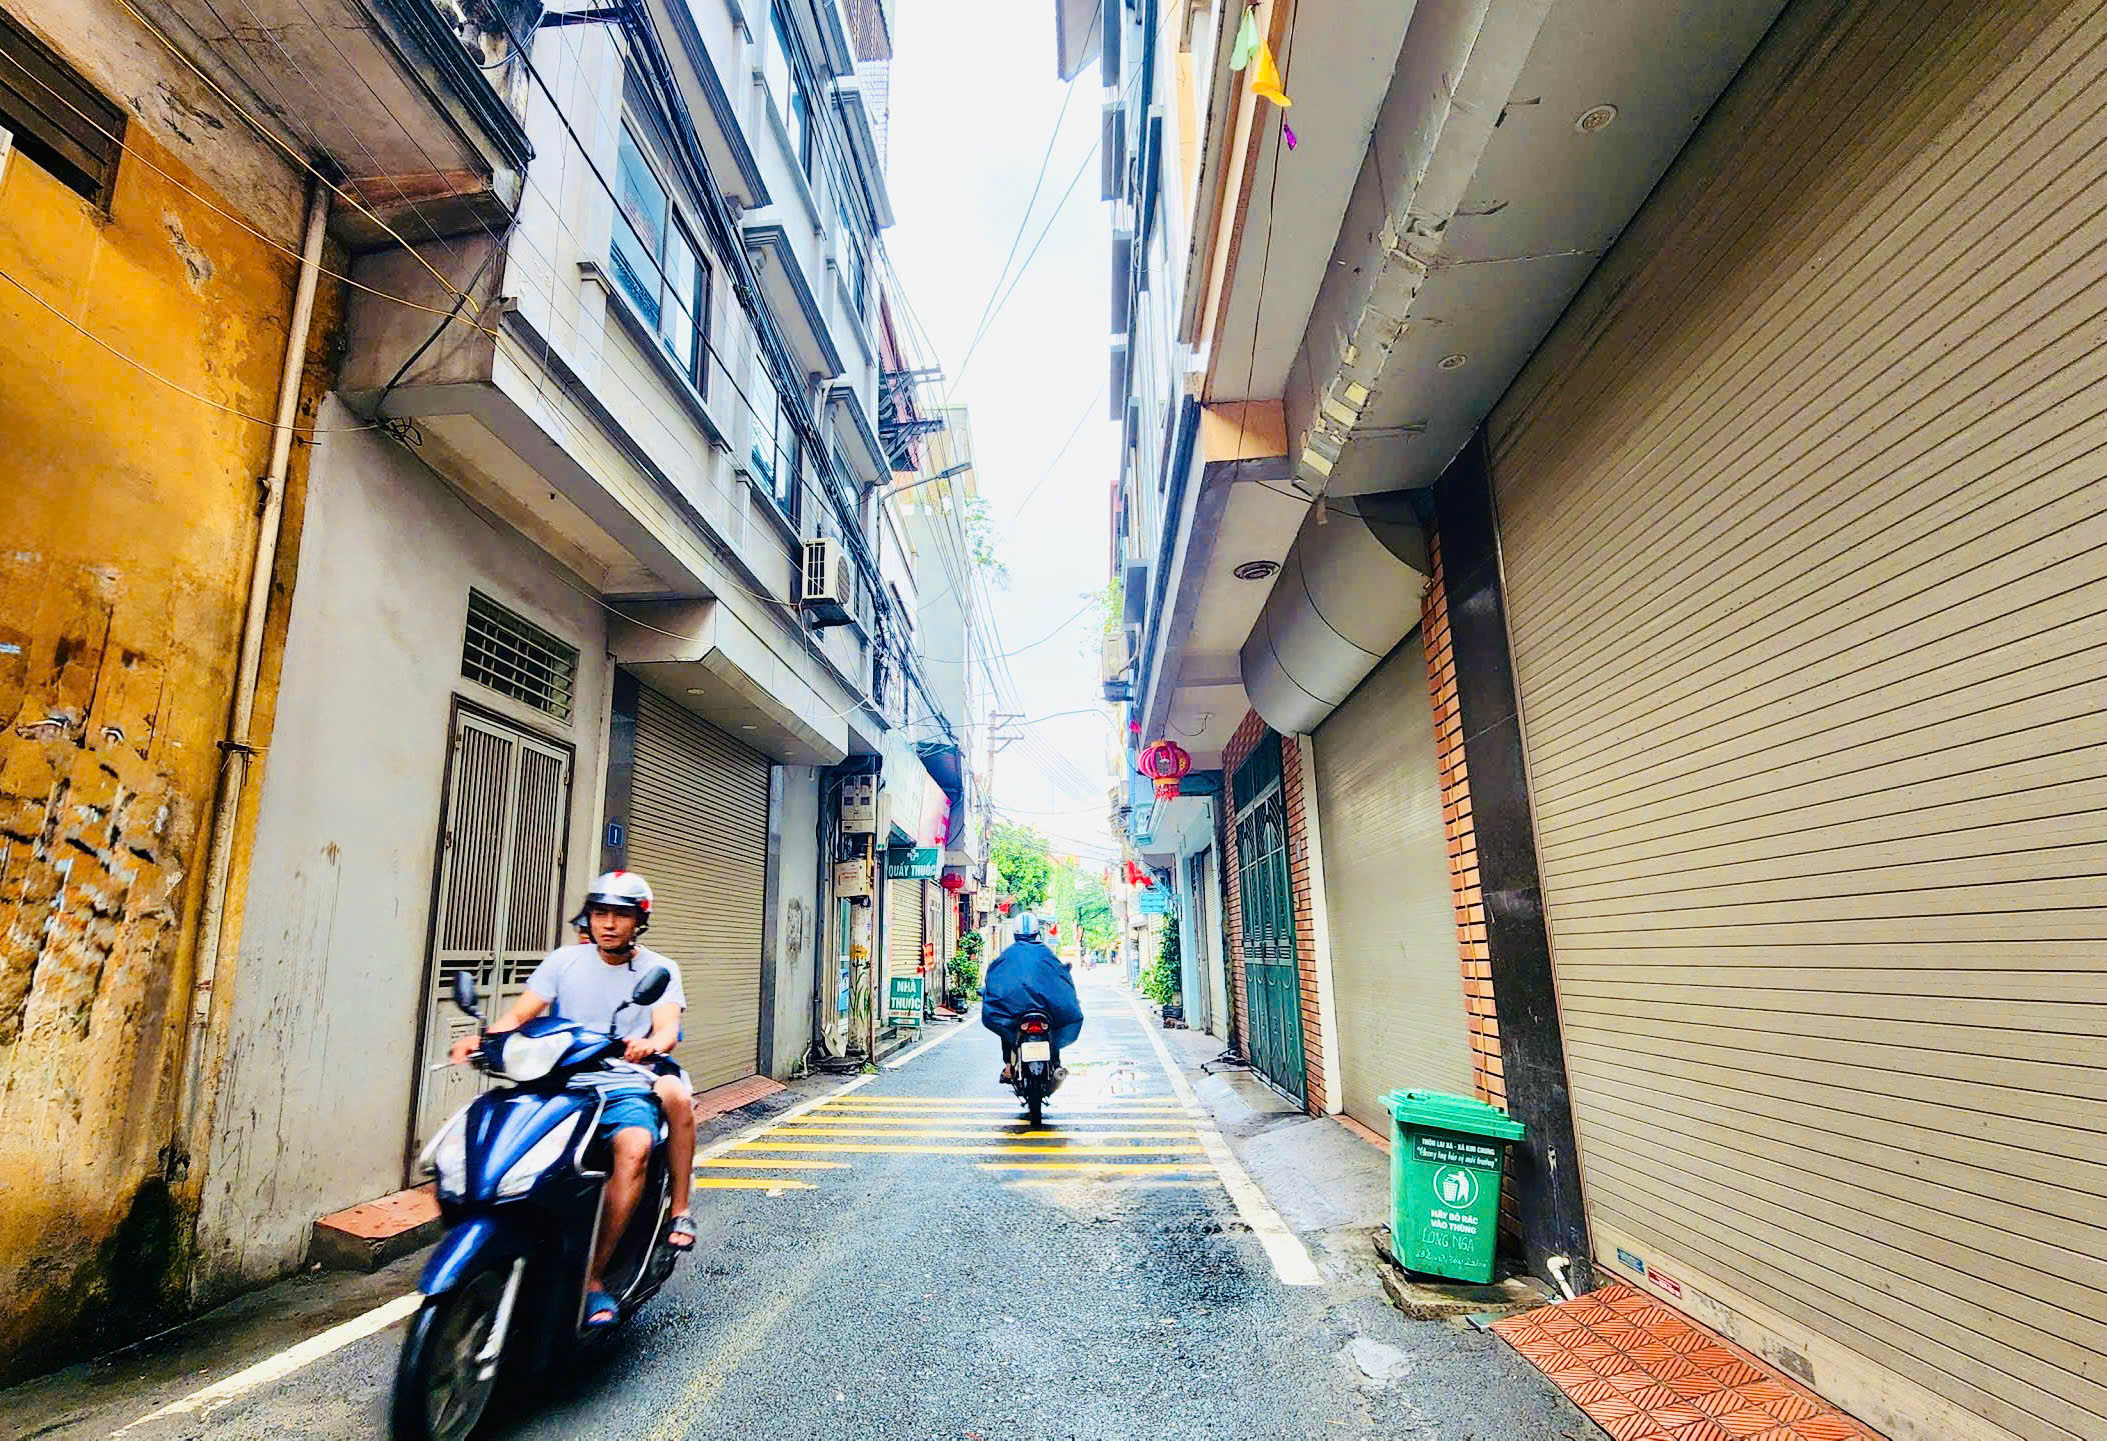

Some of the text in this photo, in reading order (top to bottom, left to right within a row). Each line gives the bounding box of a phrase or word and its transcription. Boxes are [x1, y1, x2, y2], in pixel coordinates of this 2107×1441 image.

[911, 861, 936, 877] THUỐC
[891, 994, 921, 1010] THUỐC
[1461, 1215, 1479, 1225] RÁC
